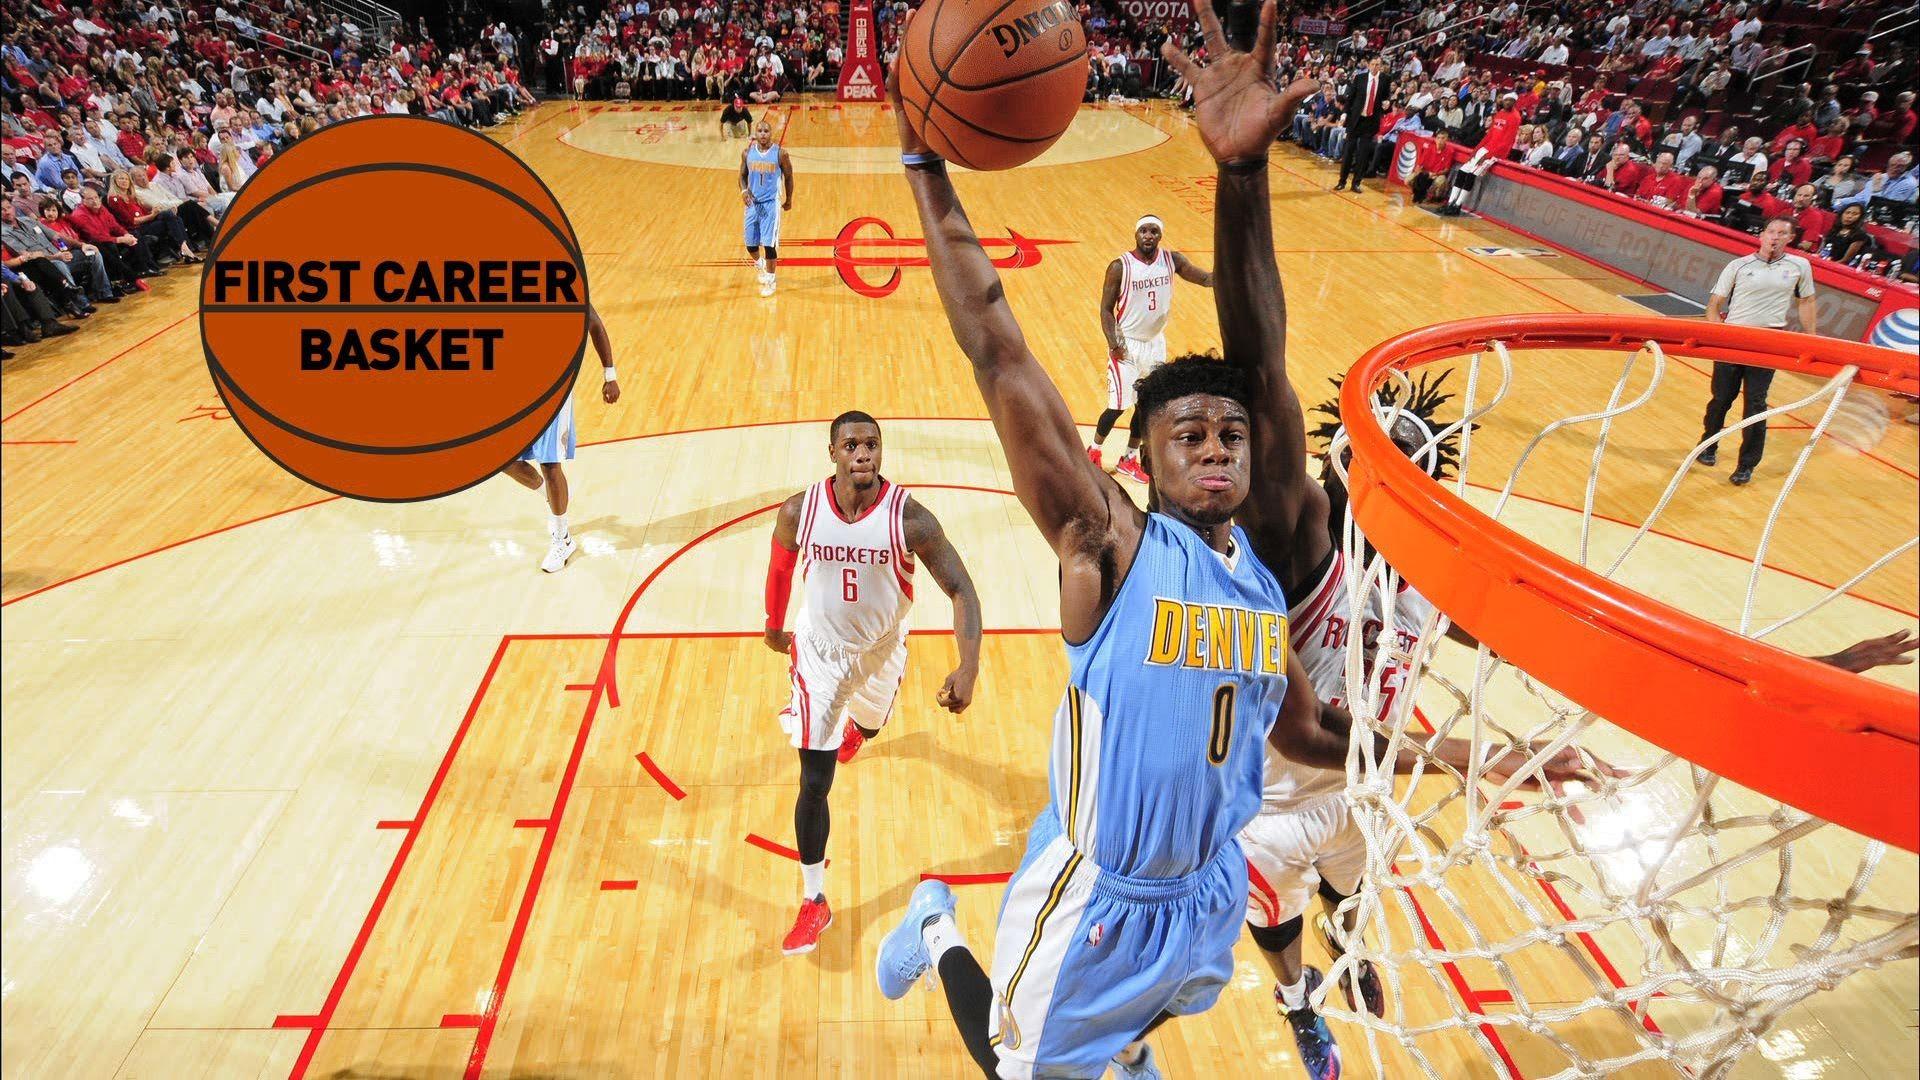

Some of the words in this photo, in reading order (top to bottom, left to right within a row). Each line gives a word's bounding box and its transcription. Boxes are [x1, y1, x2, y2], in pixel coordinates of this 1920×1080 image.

[1119, 1, 1189, 18] TOYOTA
[843, 85, 878, 99] PEAK
[1543, 202, 1568, 227] OF
[1572, 213, 1614, 248] THE
[1132, 275, 1169, 291] ROCKETS
[1147, 290, 1157, 311] 3
[811, 542, 890, 565] ROCKETS
[842, 567, 859, 603] 6
[1207, 682, 1238, 767] 0
